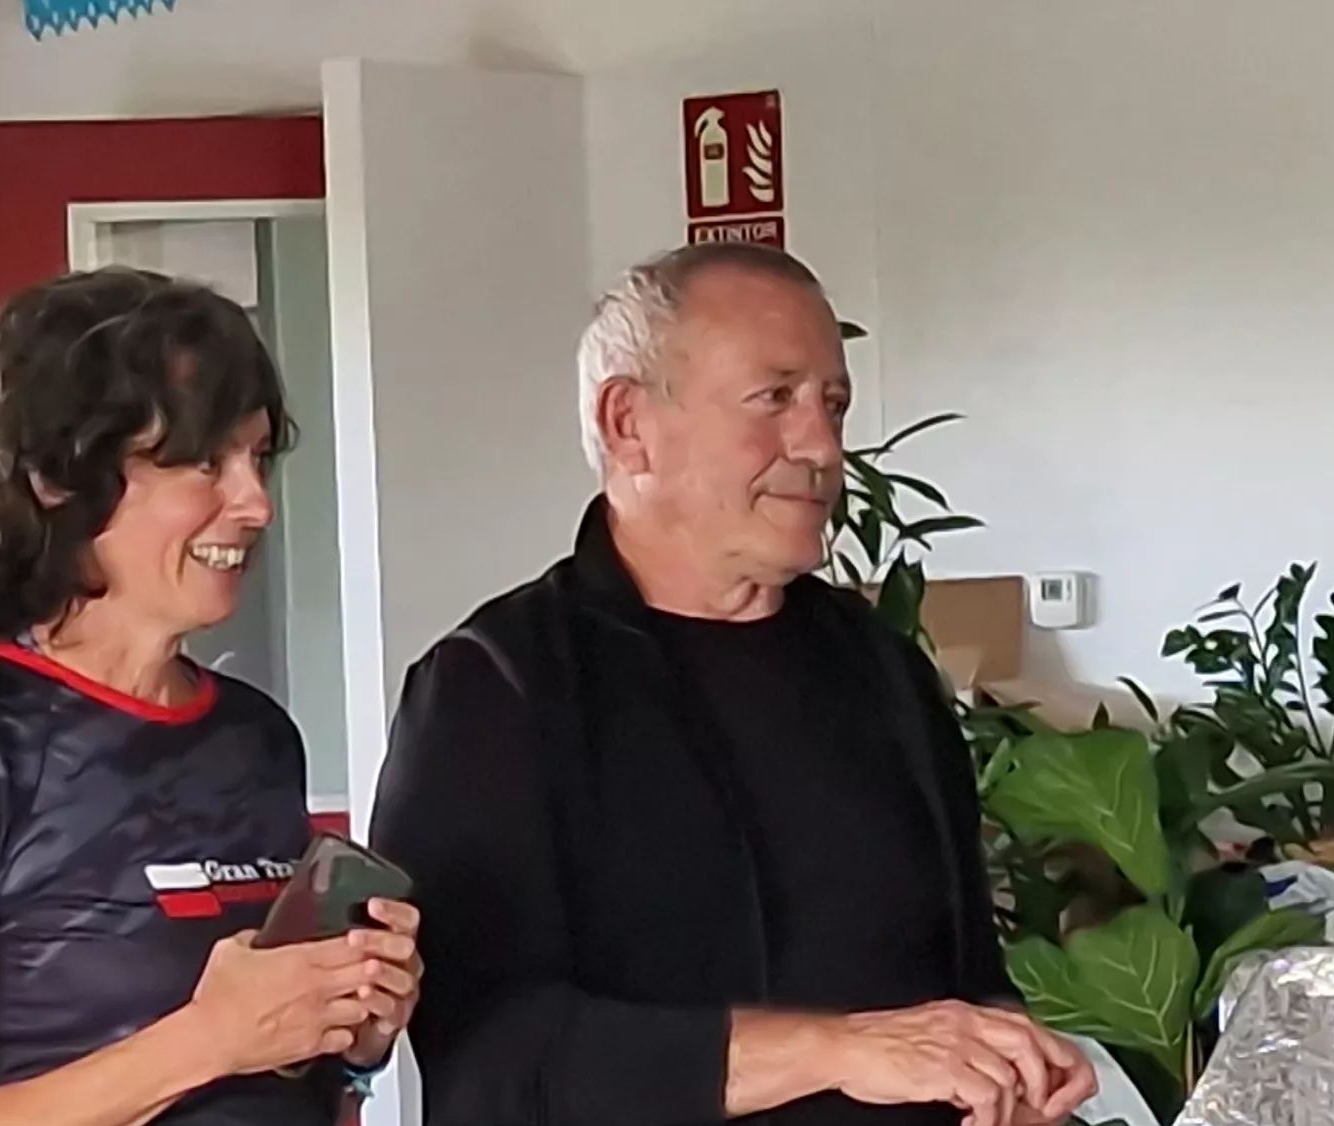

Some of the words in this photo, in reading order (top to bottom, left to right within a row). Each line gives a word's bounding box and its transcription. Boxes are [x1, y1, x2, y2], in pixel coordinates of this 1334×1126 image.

[695, 221, 777, 246] EXTINTOR
[204, 859, 260, 881] Gran
[257, 857, 296, 879] Tra
